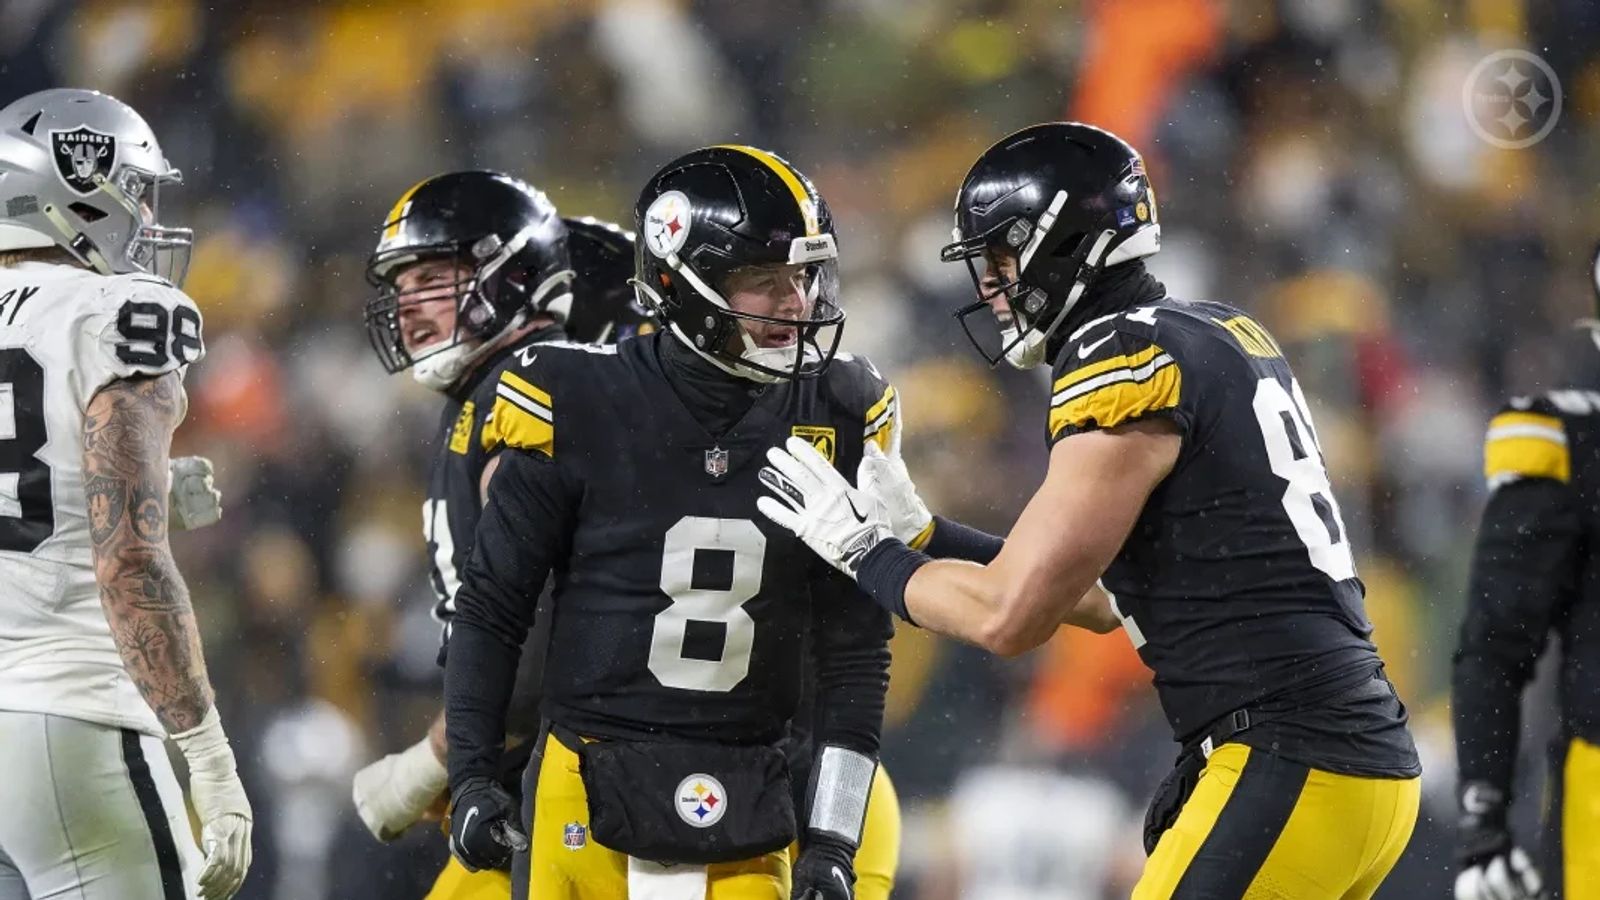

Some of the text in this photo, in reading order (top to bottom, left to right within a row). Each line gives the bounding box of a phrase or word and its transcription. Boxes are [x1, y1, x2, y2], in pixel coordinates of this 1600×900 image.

[58, 133, 110, 144] RAIDERS
[115, 299, 202, 367] 98
[648, 515, 767, 693] 8
